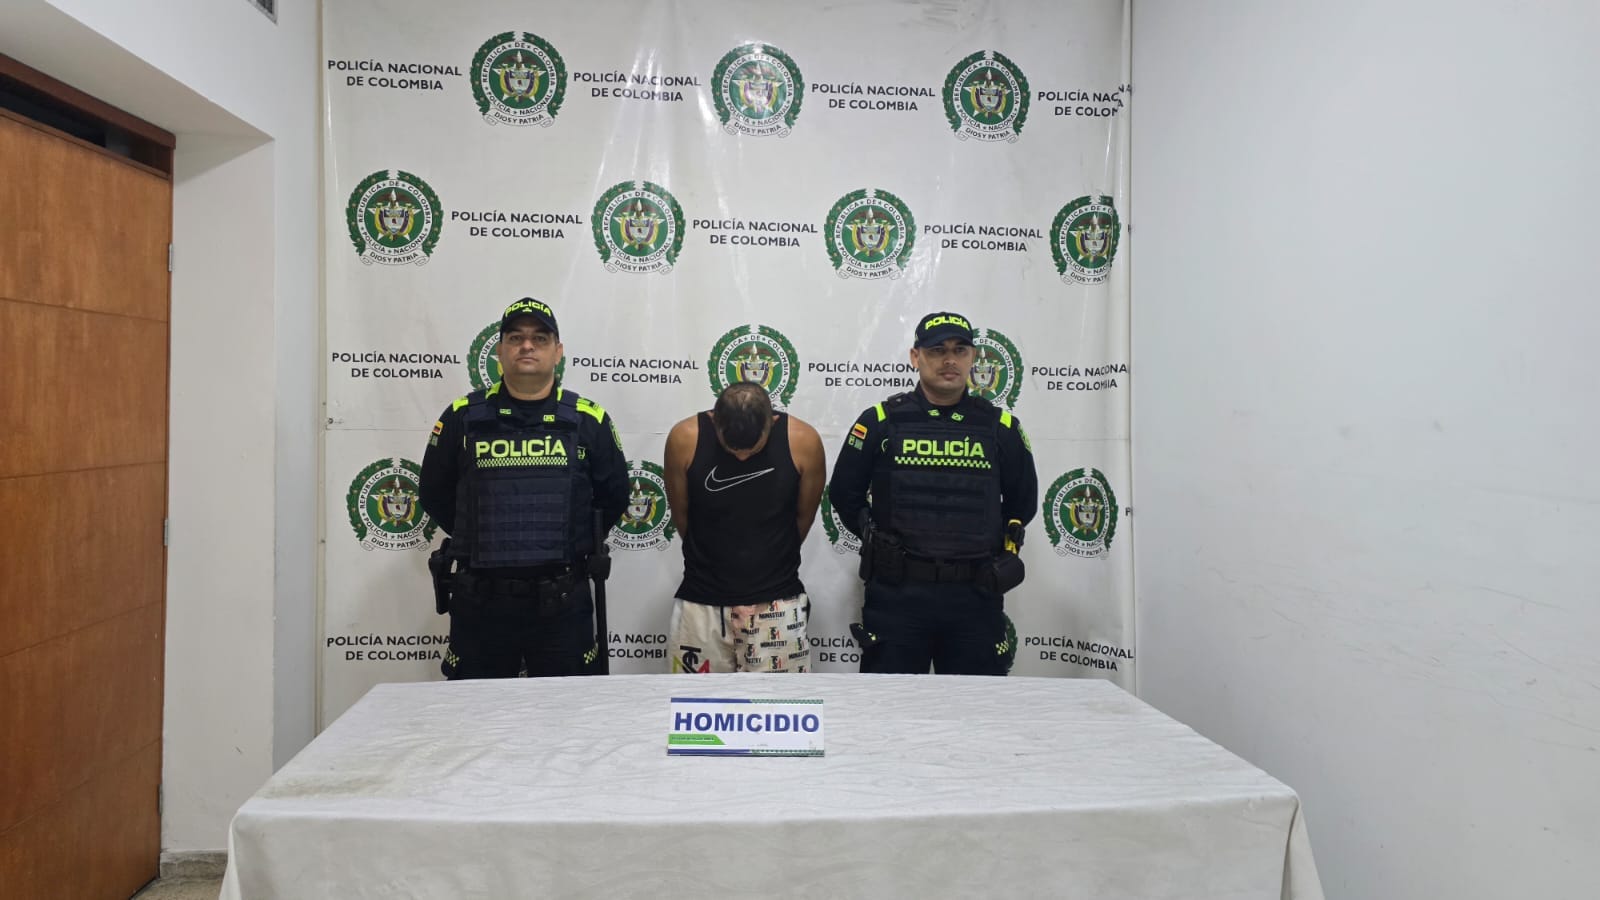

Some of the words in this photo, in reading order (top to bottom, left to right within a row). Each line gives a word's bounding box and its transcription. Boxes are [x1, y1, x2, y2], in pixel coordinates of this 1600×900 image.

[328, 59, 384, 72] POLICÍA
[388, 63, 462, 76] NACIONAL
[533, 48, 555, 86] COLOMBIA
[347, 76, 364, 86] DE
[368, 77, 443, 90] COLOMBIA
[574, 71, 626, 83] POLICÍA
[631, 74, 701, 86] NACIONAL
[1001, 67, 1020, 105] COLOMBIA
[592, 88, 608, 97] DE
[612, 88, 683, 101] COLOMBIA
[812, 82, 863, 94] POLICÍA
[867, 86, 935, 96] NACIONAL
[1038, 89, 1089, 101] POLICÍA
[520, 94, 552, 115] NACIONAL
[829, 99, 845, 108] DE
[849, 100, 918, 110] COLOMBIA
[1055, 106, 1071, 115] DE
[988, 113, 1017, 130] NACIONAL
[408, 186, 431, 224] COLOMBIA
[452, 210, 506, 222] POLICÍA
[511, 214, 582, 224] NACIONAL
[653, 196, 674, 233] COLOMBIA
[884, 203, 905, 239] COLOMBIA
[470, 227, 487, 236] DE
[492, 228, 564, 238] COLOMBIA
[693, 218, 744, 230] POLICÍA
[749, 222, 818, 233] NACIONAL
[924, 223, 975, 234] POLICÍA
[979, 226, 1043, 238] NACIONAL
[394, 233, 426, 253] NACIONAL
[710, 235, 727, 244] DE
[731, 236, 800, 247] COLOMBIA
[942, 239, 958, 248] DE
[962, 240, 1027, 251] COLOMBIA
[639, 243, 670, 262] NACIONAL
[870, 248, 901, 268] NACIONAL
[332, 351, 386, 363] POLICÍA
[390, 354, 460, 364] NACIONAL
[480, 335, 500, 369] REPUBLIC
[768, 340, 788, 376] COLOMBIA
[573, 356, 625, 368] POLICÍA
[630, 359, 699, 369] NACIONAL
[808, 361, 859, 372] POLICÍA
[864, 364, 919, 372] NACION
[995, 344, 1013, 379] COLOMBIA
[351, 368, 369, 378] DE
[373, 369, 443, 378] COLOMBIA
[591, 372, 607, 382] DE
[612, 373, 682, 383] COLOMBIA
[1032, 365, 1080, 376] POLICÍA
[825, 378, 842, 386] DE
[846, 378, 914, 387] COLOMBIA
[1048, 382, 1062, 390] DE
[770, 384, 785, 399] ONAL
[475, 436, 566, 457] POLICÍA
[903, 436, 984, 457] POLICÍA
[397, 520, 428, 539] NACIONAL
[612, 526, 628, 539] LICIA
[637, 519, 669, 539] NACIONAL
[327, 634, 382, 647] POLICÍA
[387, 636, 450, 645] NACIONA
[625, 634, 666, 643] NACIO
[808, 636, 854, 647] OLICÍA
[608, 649, 666, 658] COLOMBI
[1025, 636, 1073, 648] POLICÍA
[1077, 641, 1134, 658] NACIONAL
[346, 651, 364, 660] DE
[368, 650, 441, 660] COLOMBIA
[820, 653, 836, 662] DE
[1040, 651, 1056, 660] DE
[1061, 653, 1117, 671] COLOMBIA
[674, 712, 819, 732] HOMICIDIO
